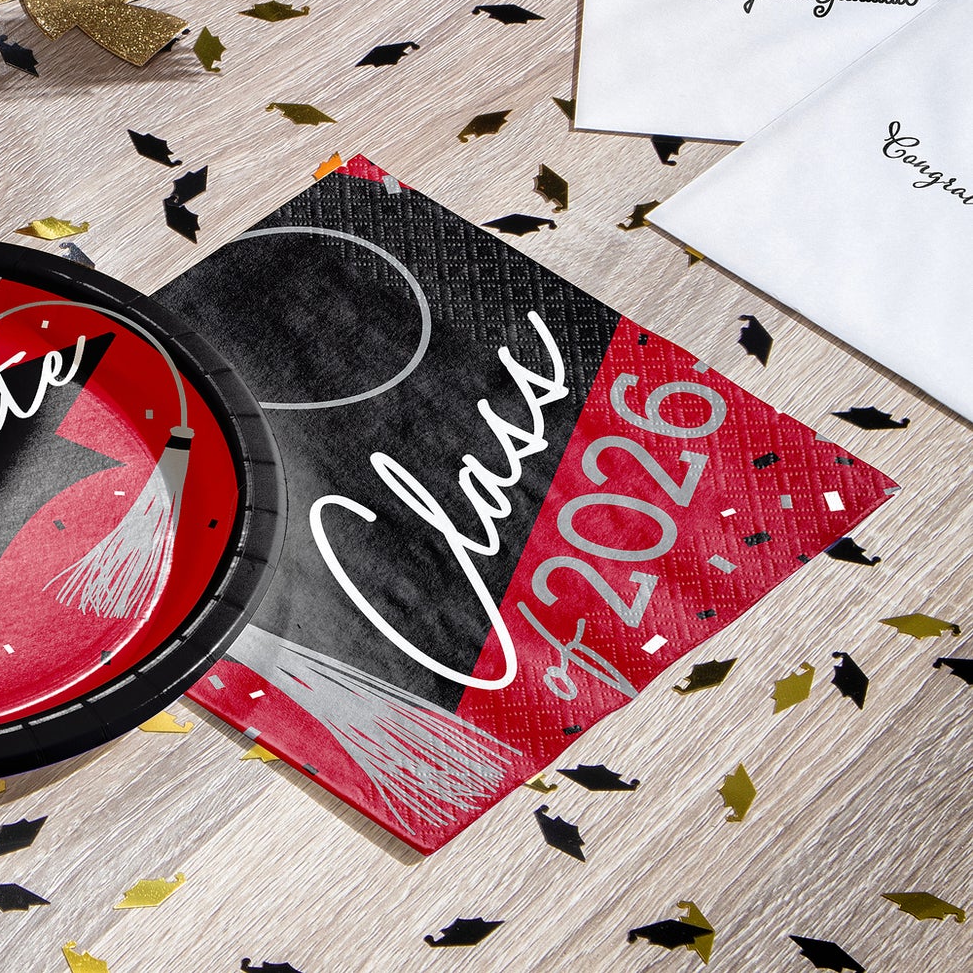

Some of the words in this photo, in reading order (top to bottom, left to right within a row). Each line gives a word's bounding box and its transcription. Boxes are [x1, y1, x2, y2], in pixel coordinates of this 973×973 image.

[882, 120, 973, 205] Congra
[309, 310, 569, 691] Class
[531, 371, 727, 628] 2026
[517, 600, 640, 701] of
